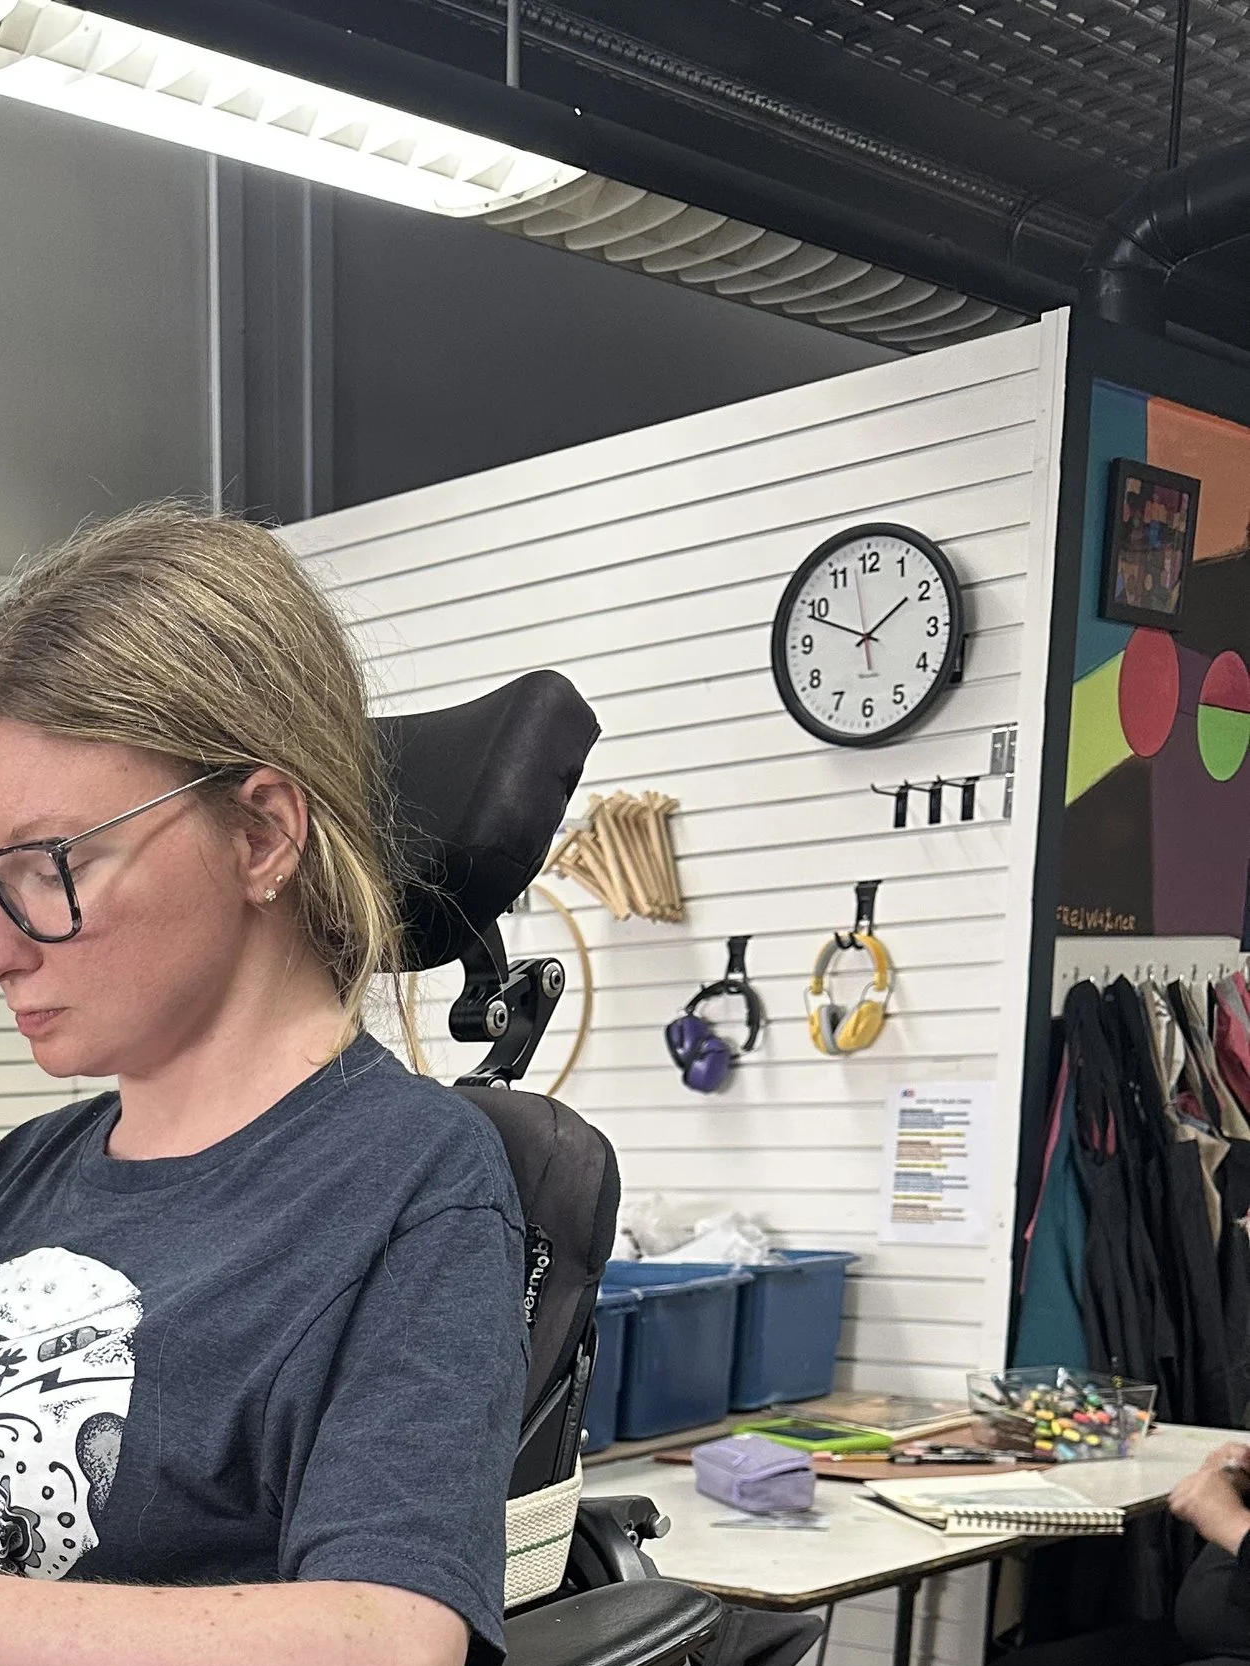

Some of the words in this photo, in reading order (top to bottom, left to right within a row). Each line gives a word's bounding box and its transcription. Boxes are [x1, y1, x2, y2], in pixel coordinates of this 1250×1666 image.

[858, 551, 880, 574] 12
[896, 556, 905, 577] 1
[829, 567, 848, 589] 11
[917, 580, 931, 602] 2
[808, 597, 830, 619] 10
[926, 616, 939, 637] 3
[801, 634, 813, 655] 9
[915, 652, 929, 673] 4
[809, 668, 821, 689] 8
[832, 691, 845, 711] 7
[892, 684, 905, 705] 5
[861, 698, 874, 718] 6
